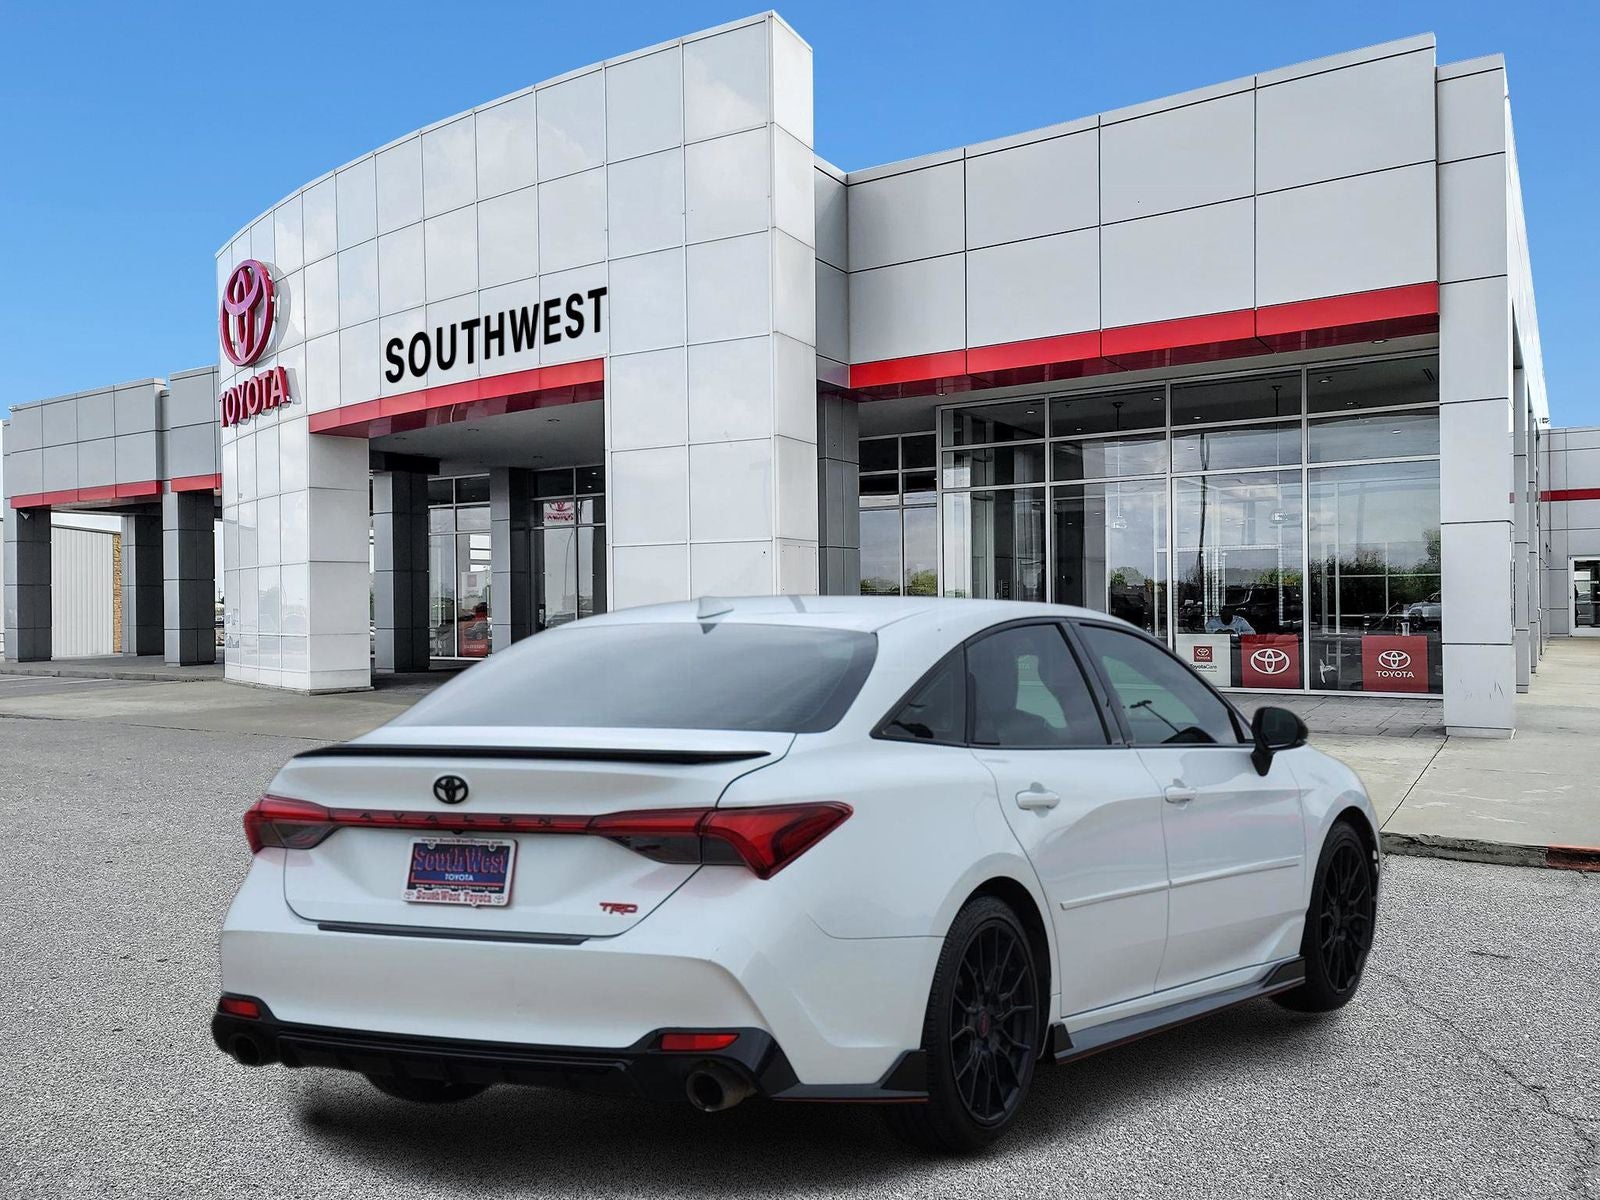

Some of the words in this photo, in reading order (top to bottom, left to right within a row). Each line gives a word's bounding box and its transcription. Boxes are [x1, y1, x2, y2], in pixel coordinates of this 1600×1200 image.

[385, 286, 608, 383] SOUTHWEST
[219, 366, 291, 428] TOYOTA
[1375, 670, 1415, 678] TOYOTA
[359, 812, 552, 826] AVALON
[445, 873, 474, 881] TOYOTA
[463, 893, 493, 904] Toyota
[599, 902, 638, 915] TRD
